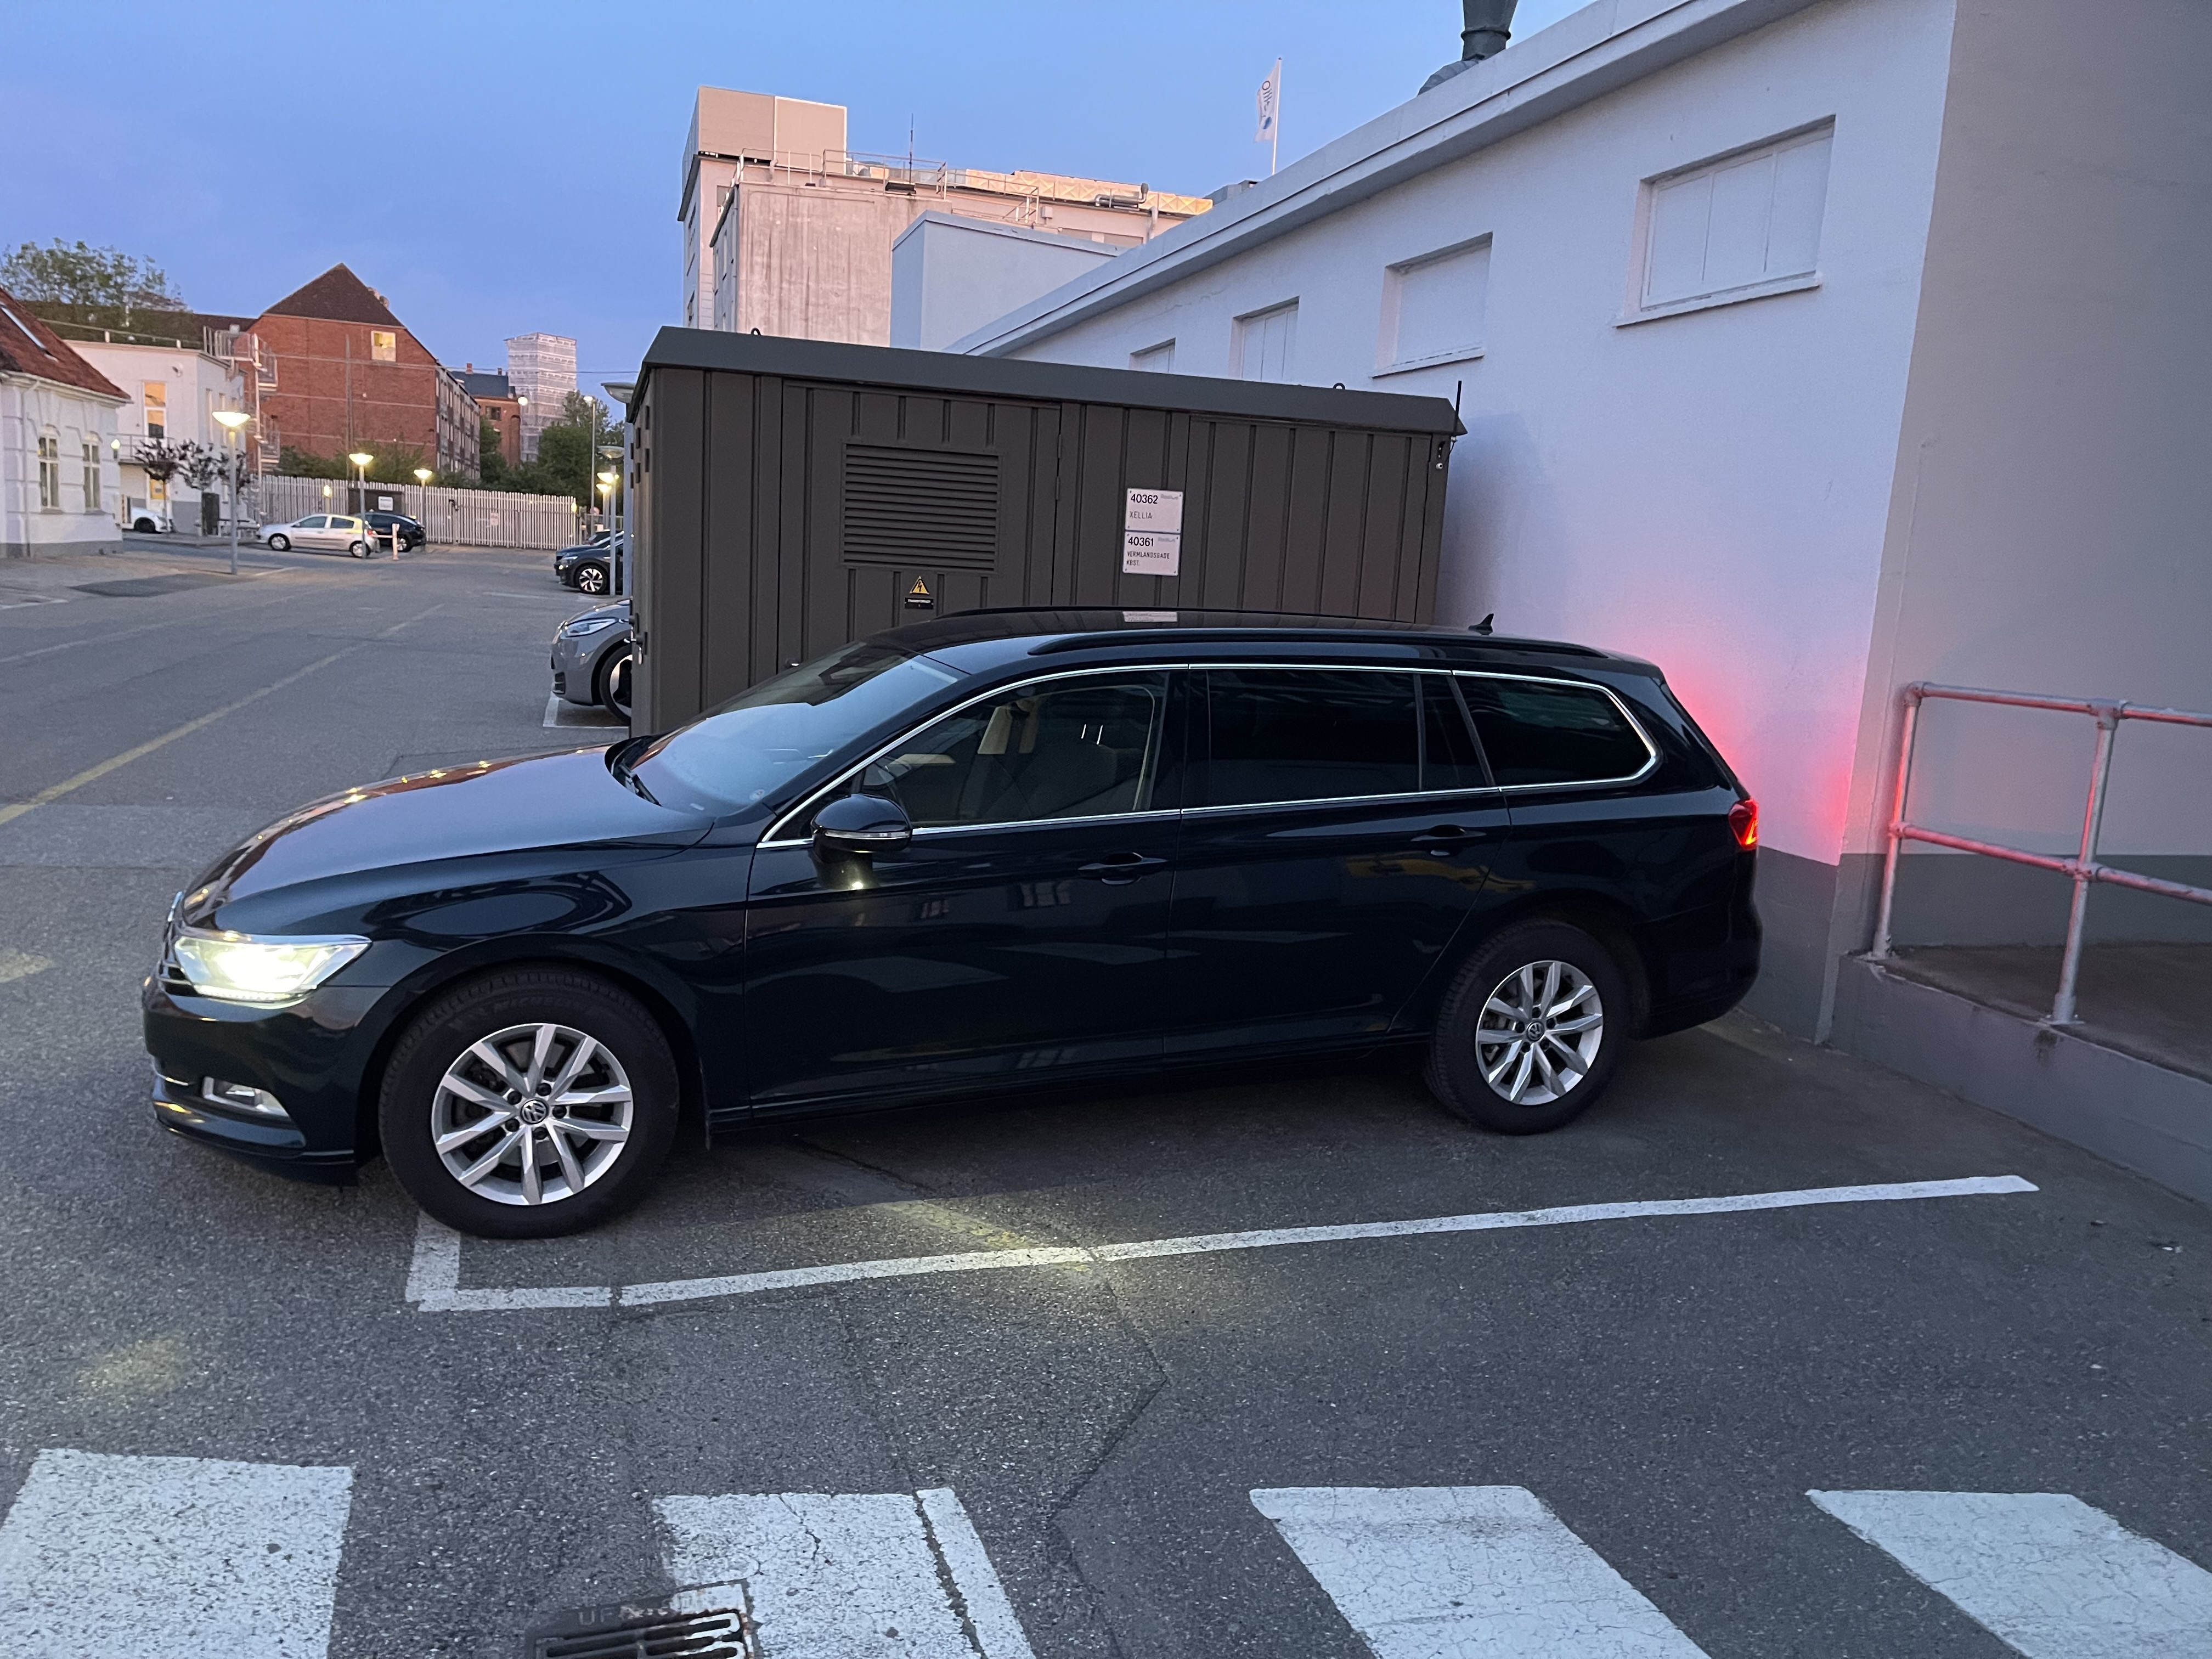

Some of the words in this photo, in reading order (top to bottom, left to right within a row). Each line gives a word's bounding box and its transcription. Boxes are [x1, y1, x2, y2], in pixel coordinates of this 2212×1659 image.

[1131, 494, 1158, 504] 40362
[1130, 511, 1152, 519] XELLIA
[1128, 537, 1154, 546] 40361
